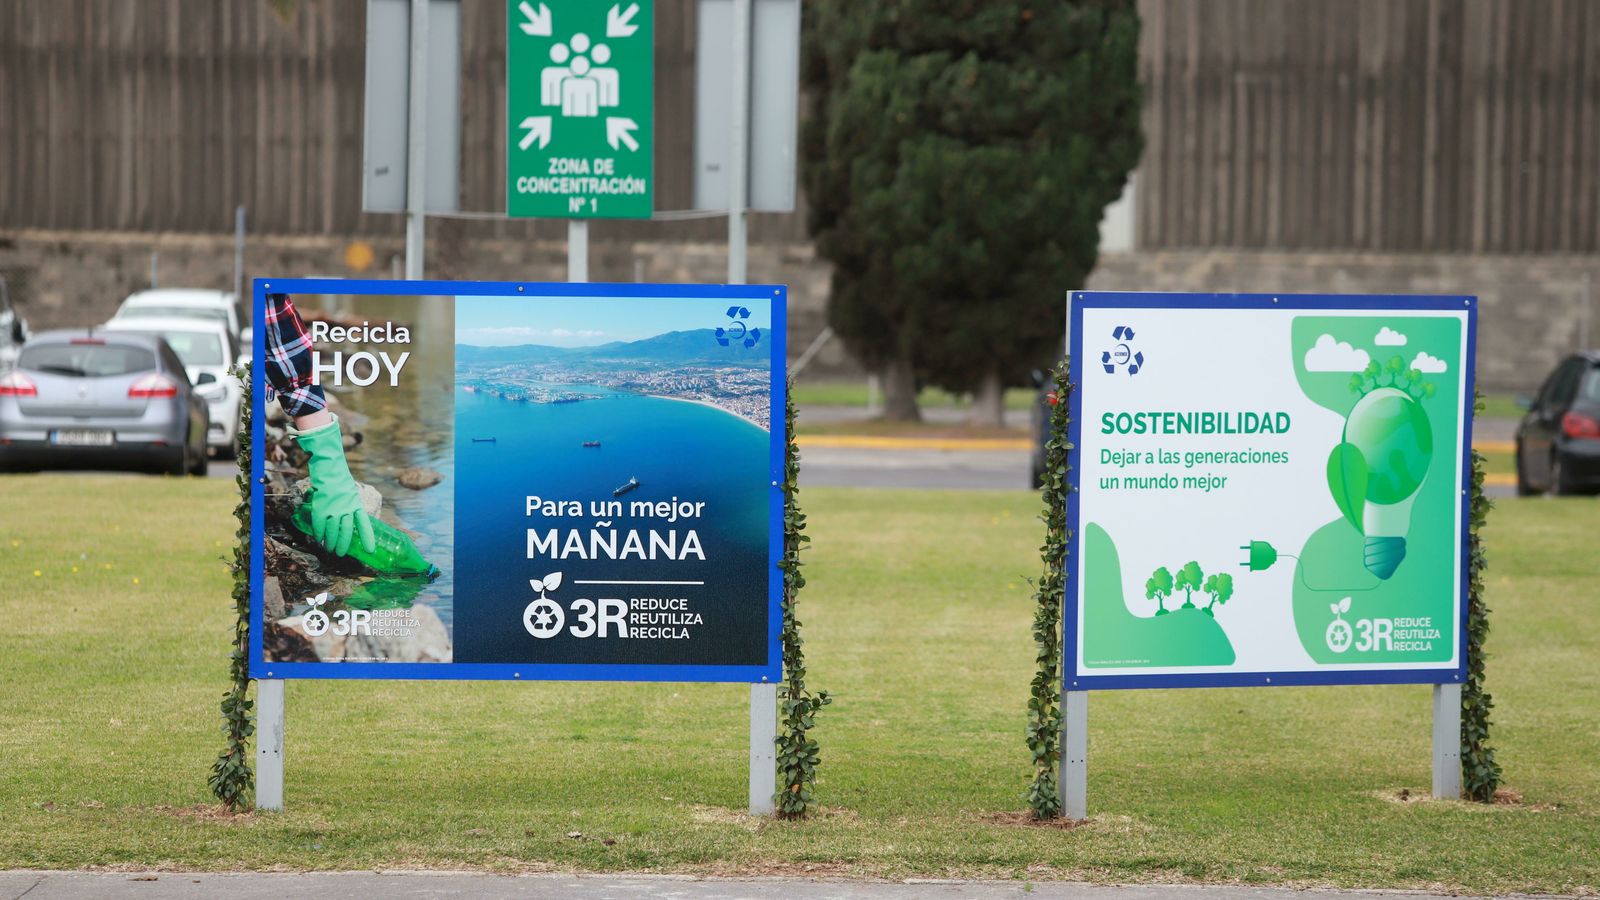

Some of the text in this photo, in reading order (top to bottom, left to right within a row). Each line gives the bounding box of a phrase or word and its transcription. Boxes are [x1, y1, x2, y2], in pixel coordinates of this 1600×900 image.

[548, 157, 615, 175] ZONA DE
[516, 174, 646, 195] CONCENTRACIÓN
[590, 197, 598, 213] 1
[312, 320, 411, 343] Recicla
[312, 351, 411, 387] HOY
[1100, 411, 1291, 435] SOSTENIBILIDAD
[1100, 447, 1289, 469] Dejar a las generaciones
[1100, 473, 1228, 493] un mundo mejor
[526, 495, 706, 523] Para un mejor
[526, 520, 707, 561] MAÑANA
[372, 609, 410, 618] REDUCE
[630, 598, 688, 611] REDUCE
[332, 609, 371, 636] 3R
[372, 619, 421, 628] REUTILIZA
[569, 598, 629, 639] 3R
[630, 612, 704, 626] REUTILIZA
[1393, 617, 1431, 628] REDUCE
[372, 629, 411, 637] RECICLA
[630, 627, 690, 640] RECICLA
[1355, 618, 1393, 652] 3R
[1393, 629, 1441, 640] REUTILIZA
[1393, 641, 1432, 651] RECICLA
